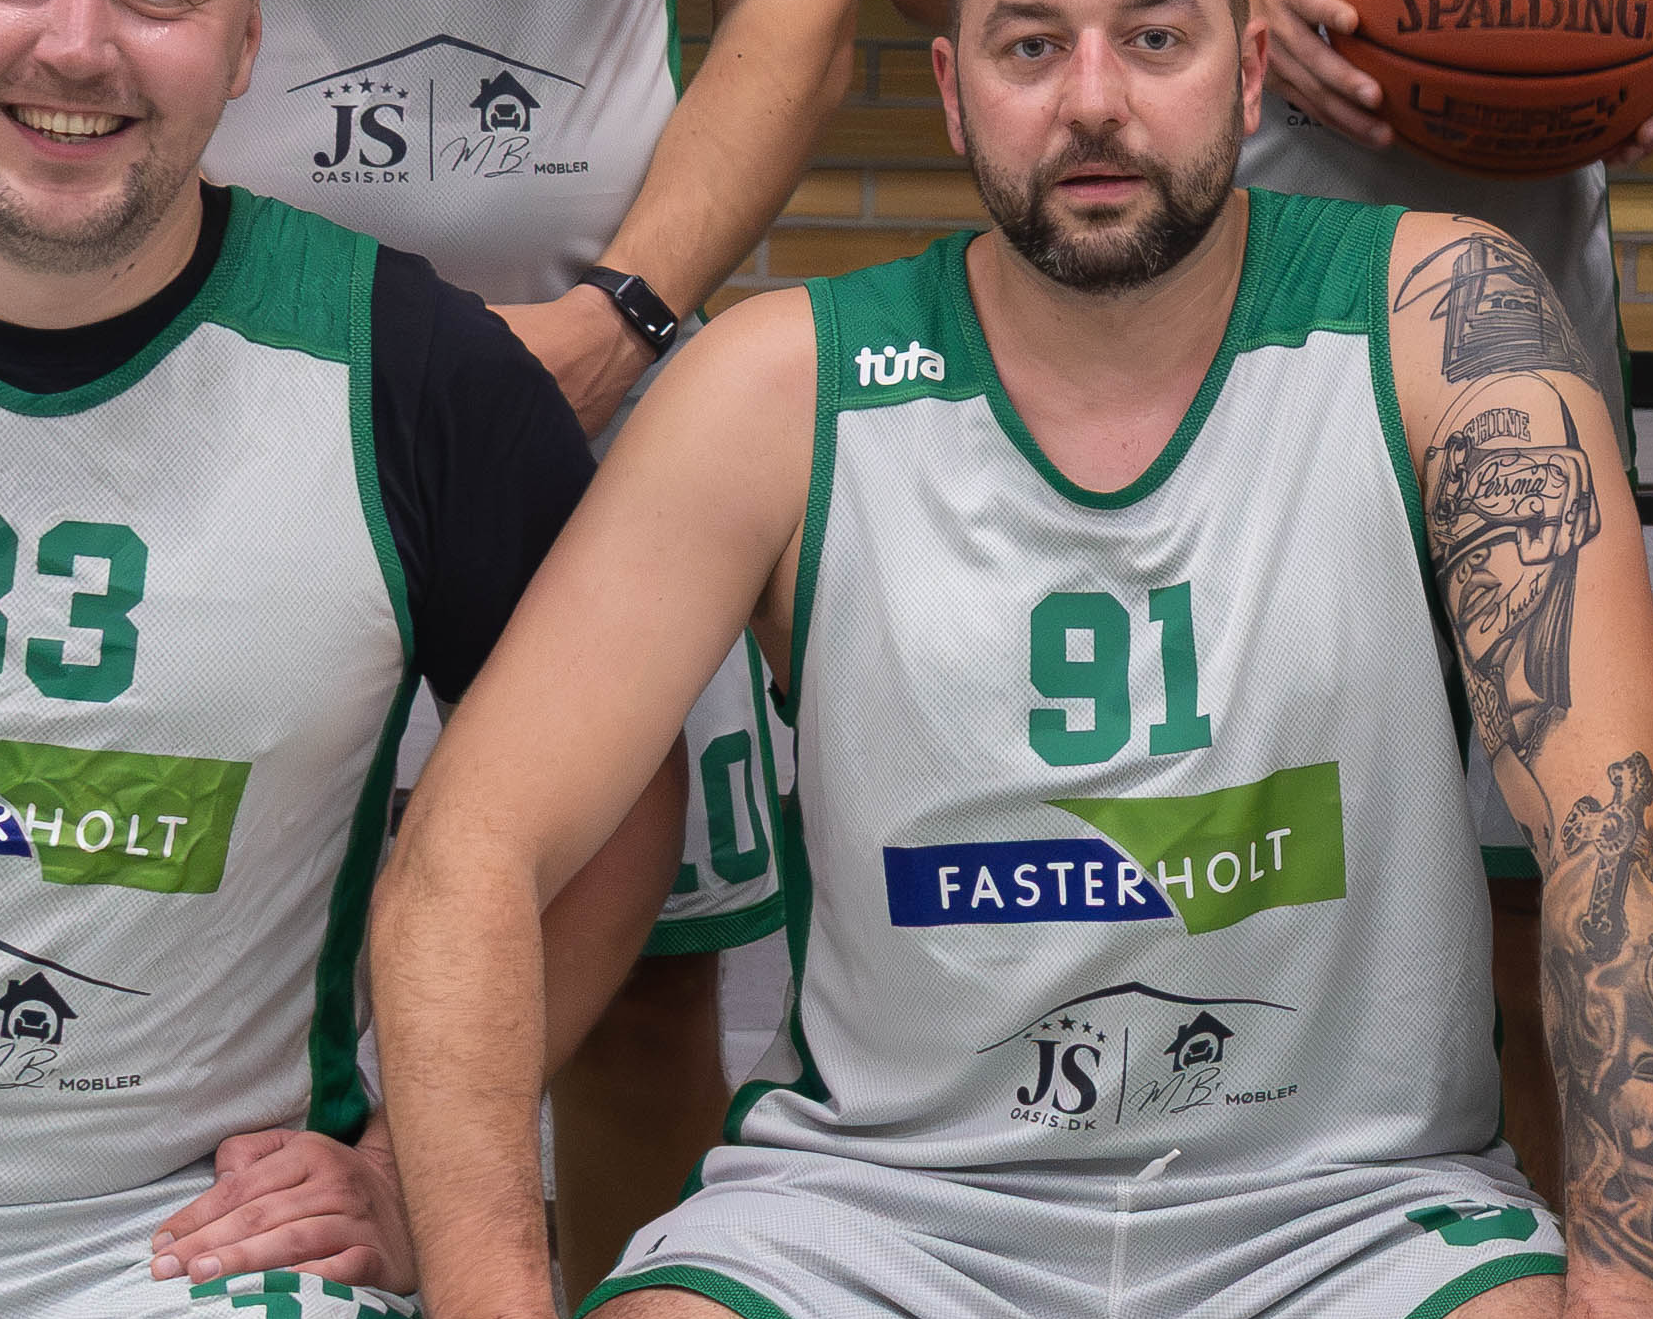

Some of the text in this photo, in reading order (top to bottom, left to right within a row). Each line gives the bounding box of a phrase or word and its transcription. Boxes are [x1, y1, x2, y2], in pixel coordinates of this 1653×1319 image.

[313, 104, 409, 168] JS
[312, 169, 411, 186] OASIS.DK
[1028, 580, 1214, 768] 91
[670, 729, 772, 896] 0
[937, 827, 1293, 911] FASTERHOLT
[1016, 1039, 1102, 1115] JS
[1010, 1106, 1097, 1131] OASIS.DK
